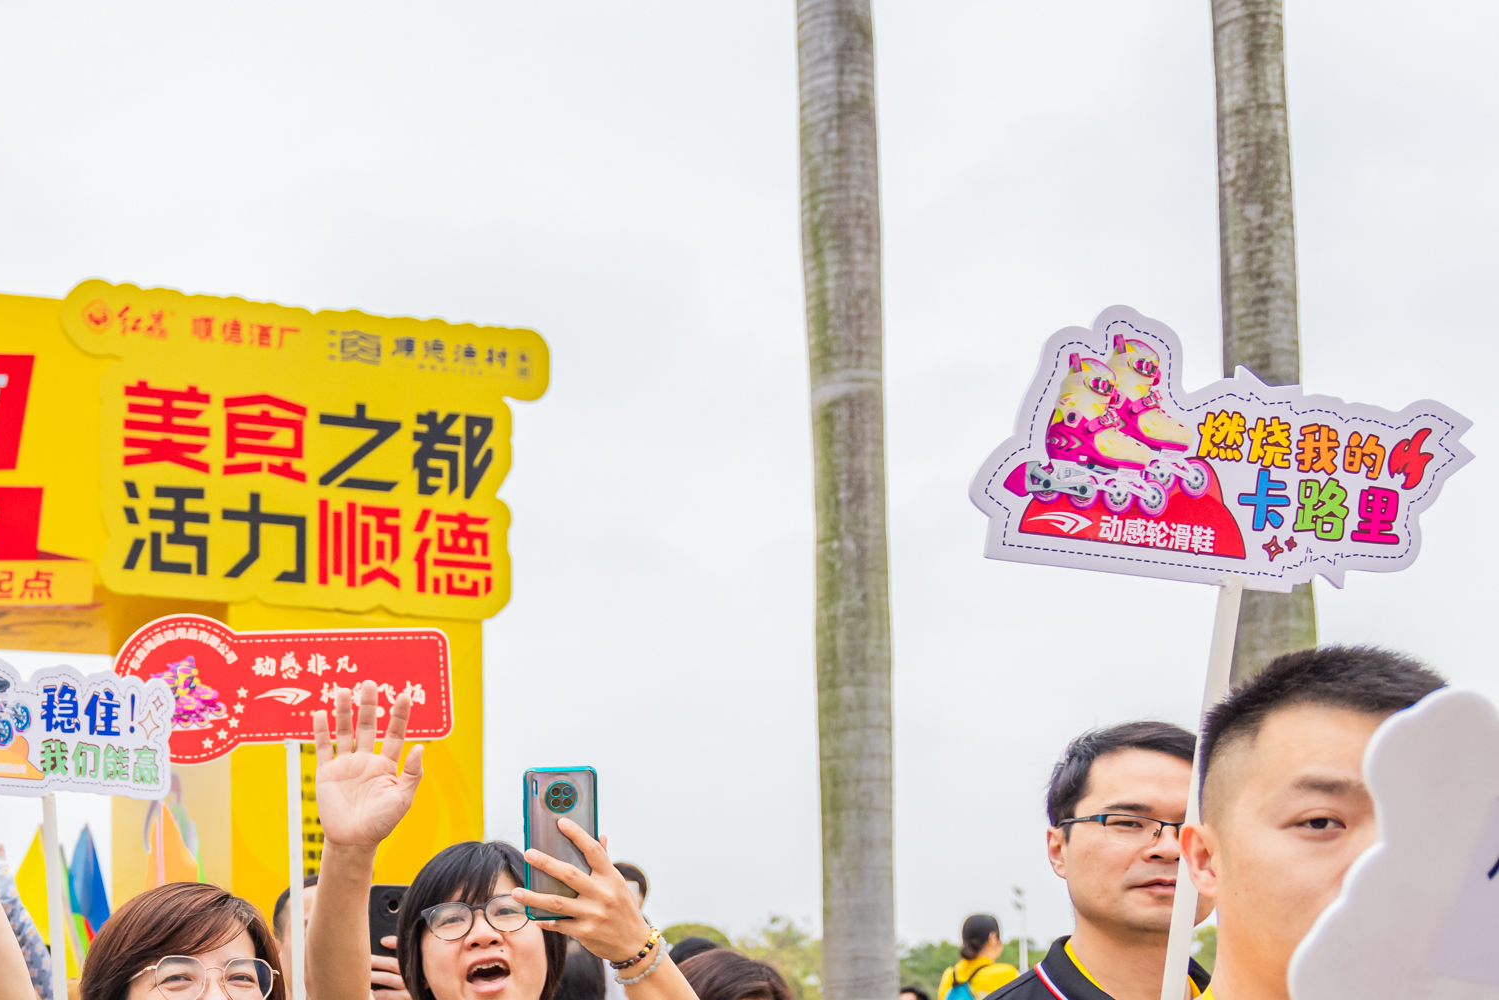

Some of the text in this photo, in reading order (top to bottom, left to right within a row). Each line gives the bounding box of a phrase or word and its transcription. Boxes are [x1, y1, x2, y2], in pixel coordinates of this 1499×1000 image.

[122, 380, 495, 500] 美食之都
[1198, 410, 1387, 480] 燃烧我的
[1098, 515, 1215, 555] 动感轮滑鞋
[1238, 469, 1401, 546] 卡路里
[122, 480, 494, 599] 活力顺德
[252, 651, 358, 680] 动感非凡
[41, 682, 136, 737] 稳住!
[40, 739, 160, 786] 我们能赢
